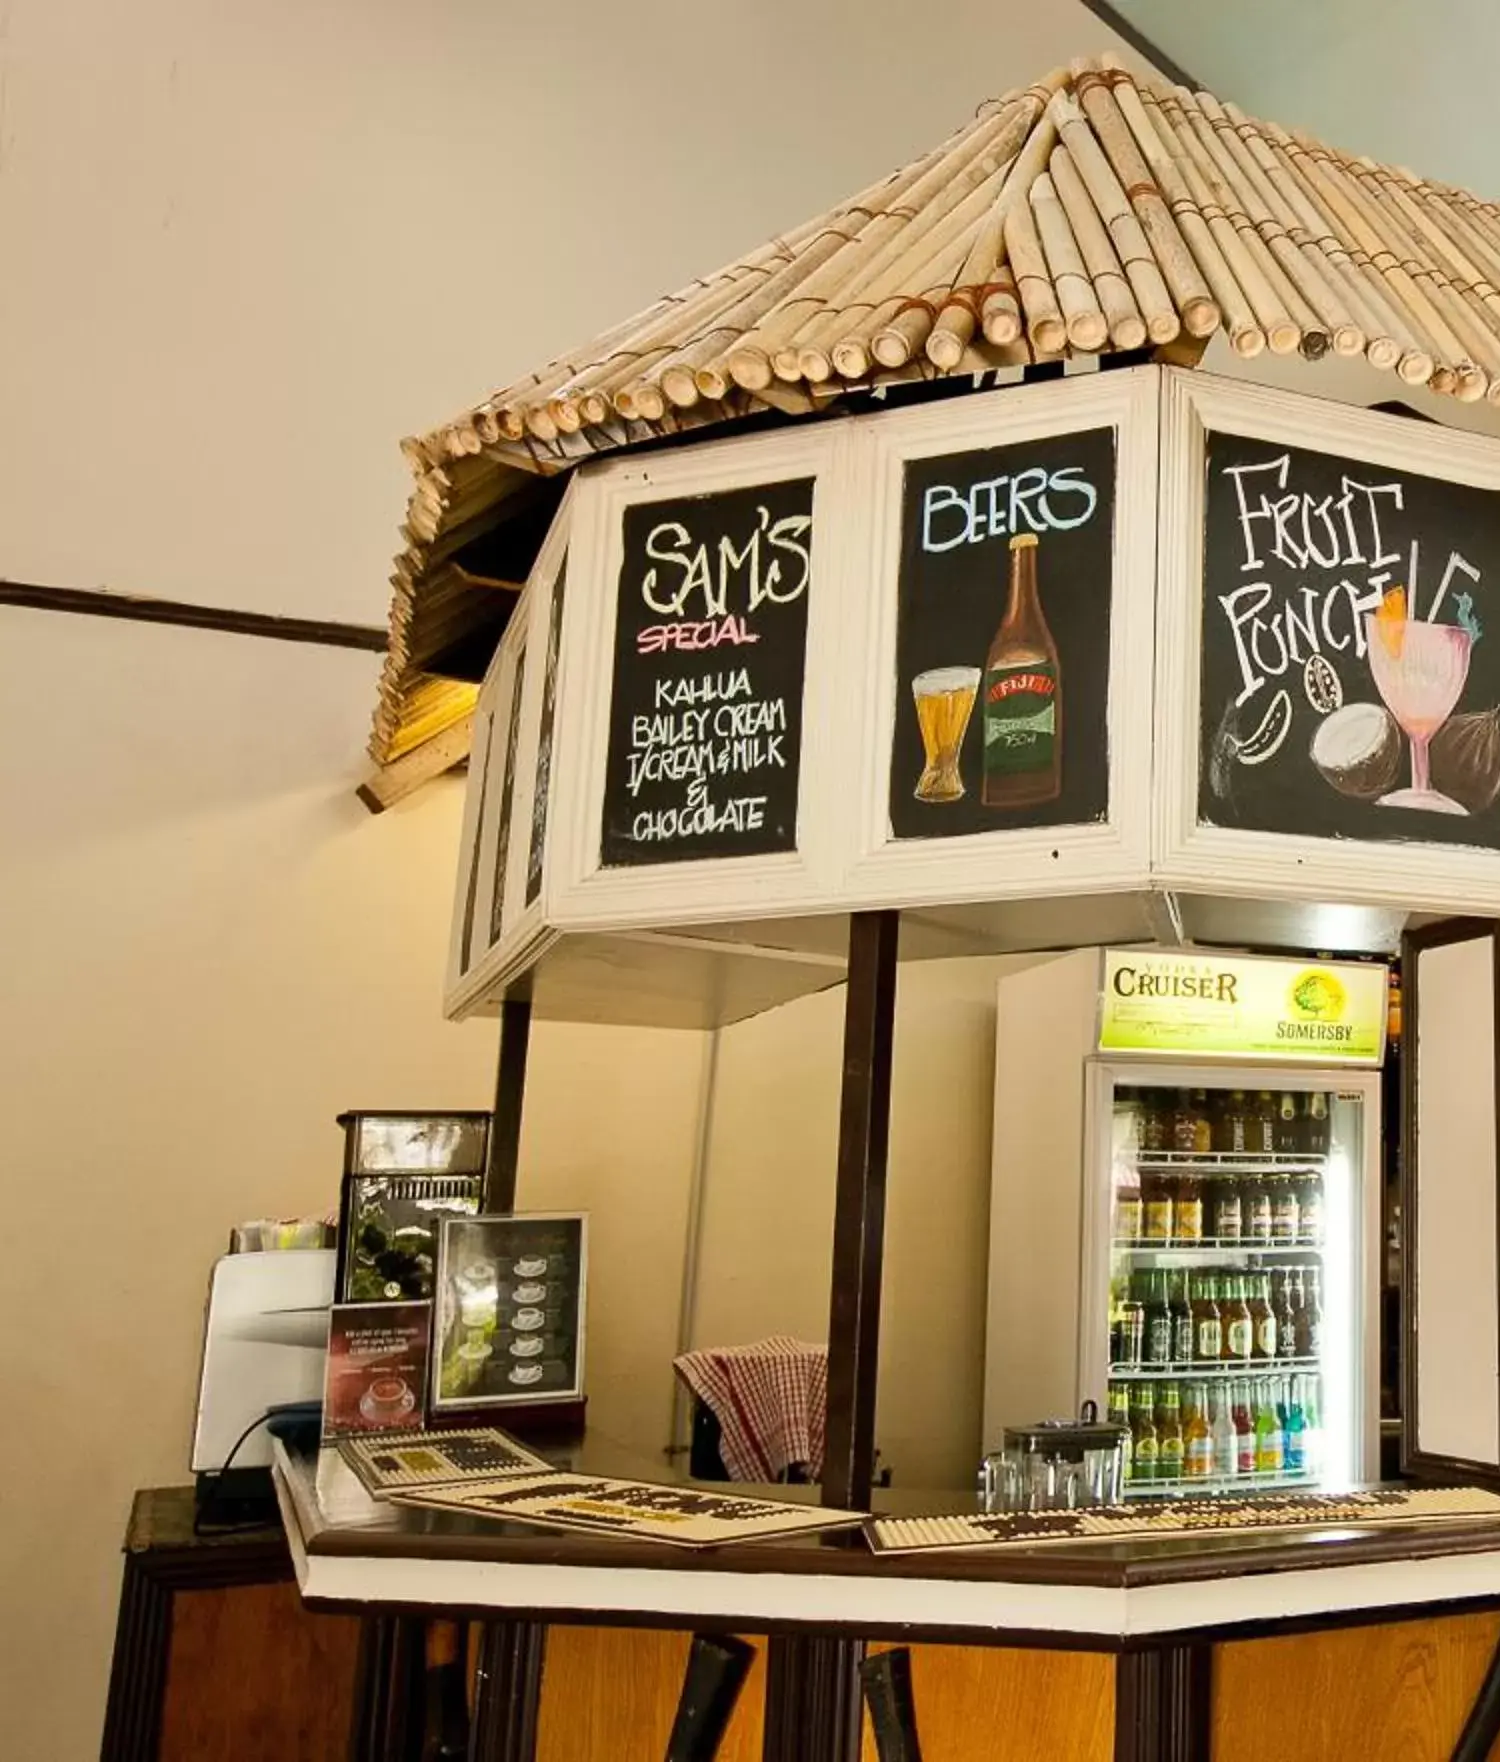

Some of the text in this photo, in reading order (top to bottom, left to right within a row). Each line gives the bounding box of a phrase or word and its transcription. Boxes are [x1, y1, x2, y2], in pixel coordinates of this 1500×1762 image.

[922, 467, 1097, 553] BEERS
[1222, 453, 1404, 571] FRUIT
[642, 506, 812, 618] SAM'S
[637, 614, 761, 654] SPECIAL
[1218, 572, 1392, 708] PUNCH
[655, 667, 753, 708] KAHLUA
[632, 697, 787, 747] BAILEY CREAM
[733, 735, 787, 774] MILK
[633, 796, 768, 842] CHOCOLATE
[1113, 966, 1238, 1004] CRUISER
[1276, 1020, 1353, 1041] SOMERSBY
